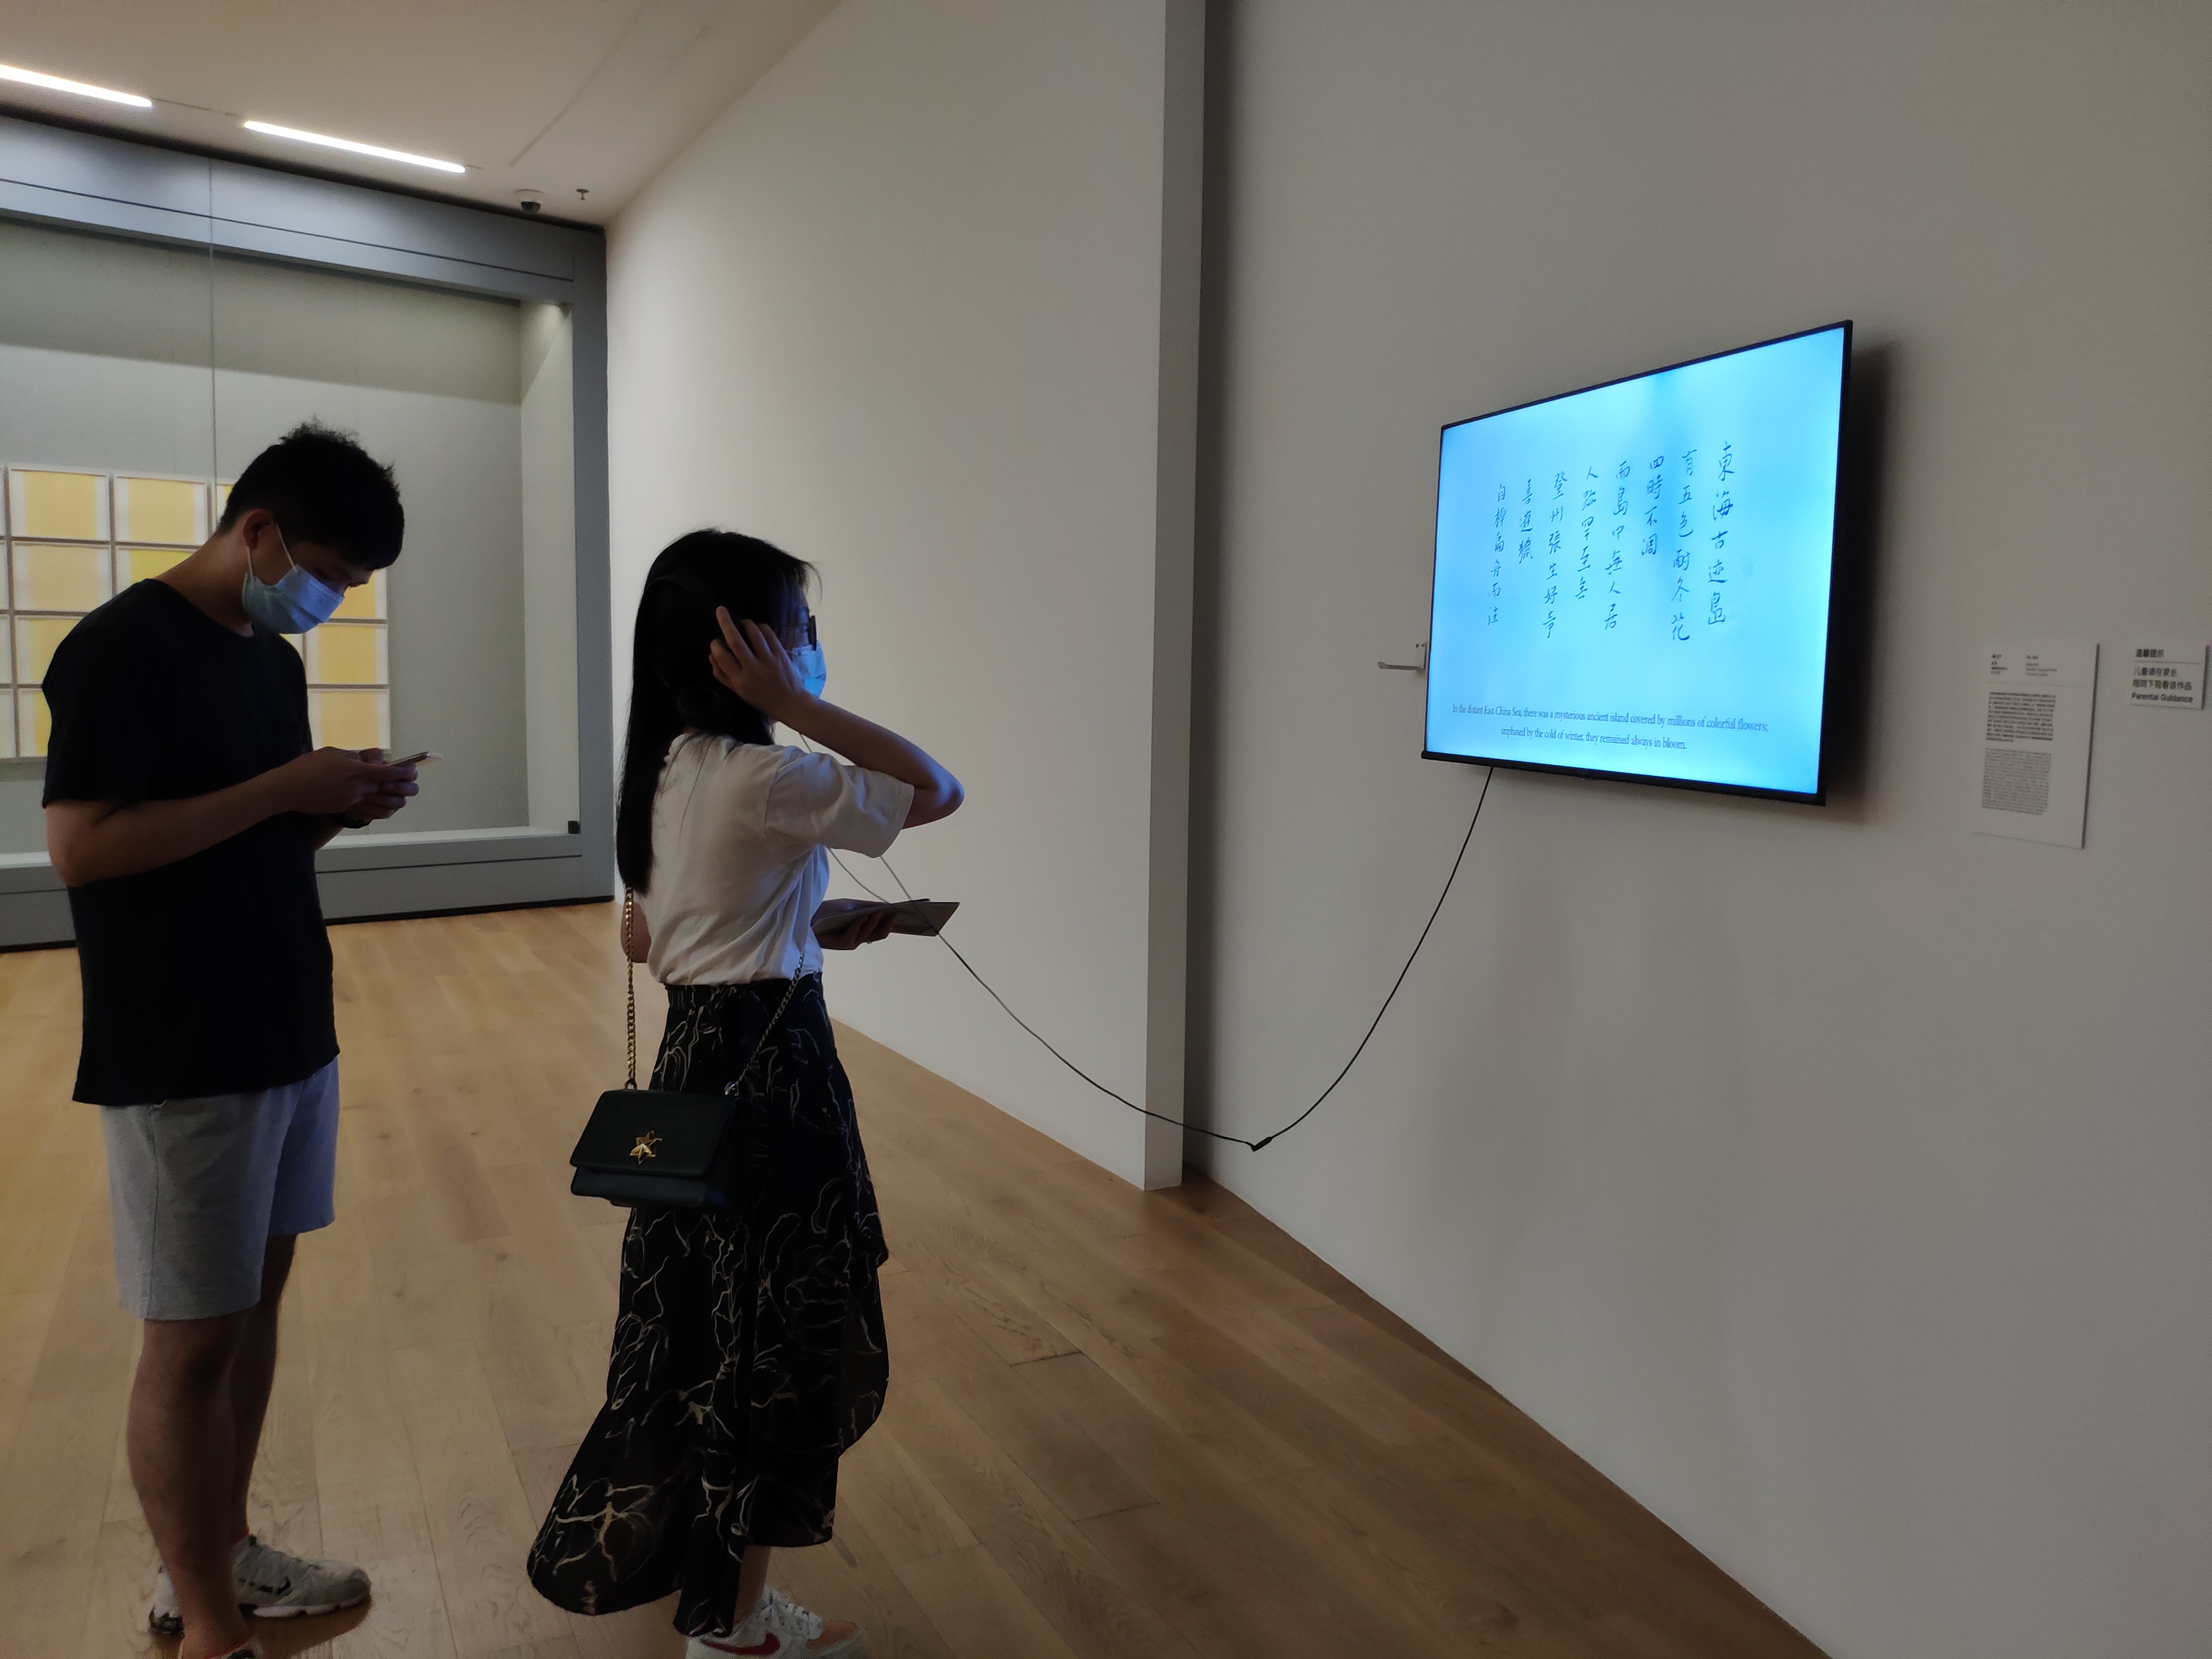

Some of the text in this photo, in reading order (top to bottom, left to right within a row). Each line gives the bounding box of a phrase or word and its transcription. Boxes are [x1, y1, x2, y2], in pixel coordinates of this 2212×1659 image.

[2131, 692, 2193, 703] Parental Guidance
[1453, 704, 1458, 713] In
[1467, 705, 1483, 714] distant
[1484, 706, 1494, 715] East
[1495, 706, 1511, 716] China
[1512, 707, 1522, 718] Sea,
[1523, 707, 1537, 718] there
[1554, 710, 1585, 722] mysterious
[1587, 712, 1609, 722] ancient
[1610, 712, 1629, 723] island
[1630, 714, 1655, 724] covered
[1657, 714, 1666, 728] by
[1667, 715, 1696, 727] millions
[1697, 716, 1707, 727] of
[1706, 717, 1735, 730] colorful
[1737, 718, 1768, 733] flowers;
[1501, 726, 1687, 749] unphased by the cold of winter, they remained always in bloom.
